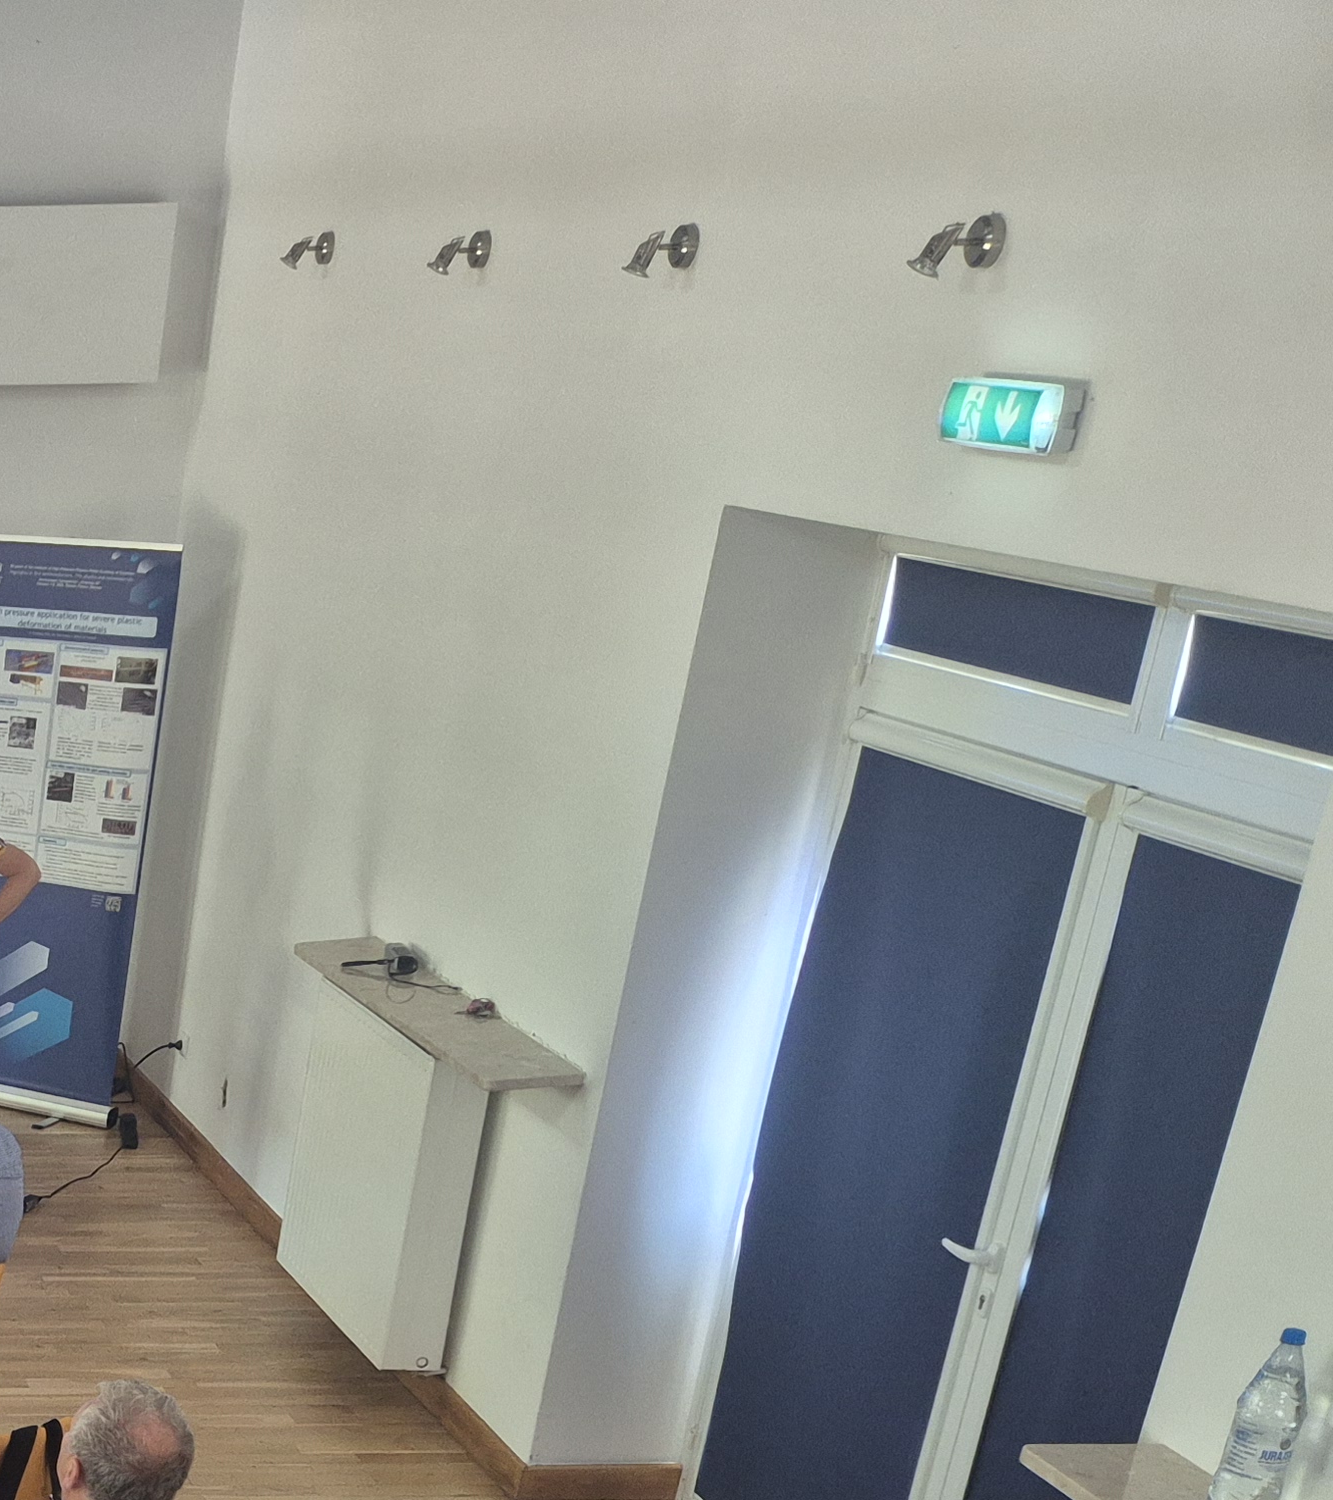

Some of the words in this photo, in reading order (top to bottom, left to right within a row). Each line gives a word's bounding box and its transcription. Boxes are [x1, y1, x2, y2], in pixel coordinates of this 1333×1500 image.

[4, 609, 35, 619] pressure
[37, 611, 78, 621] application
[17, 620, 62, 630] deformation
